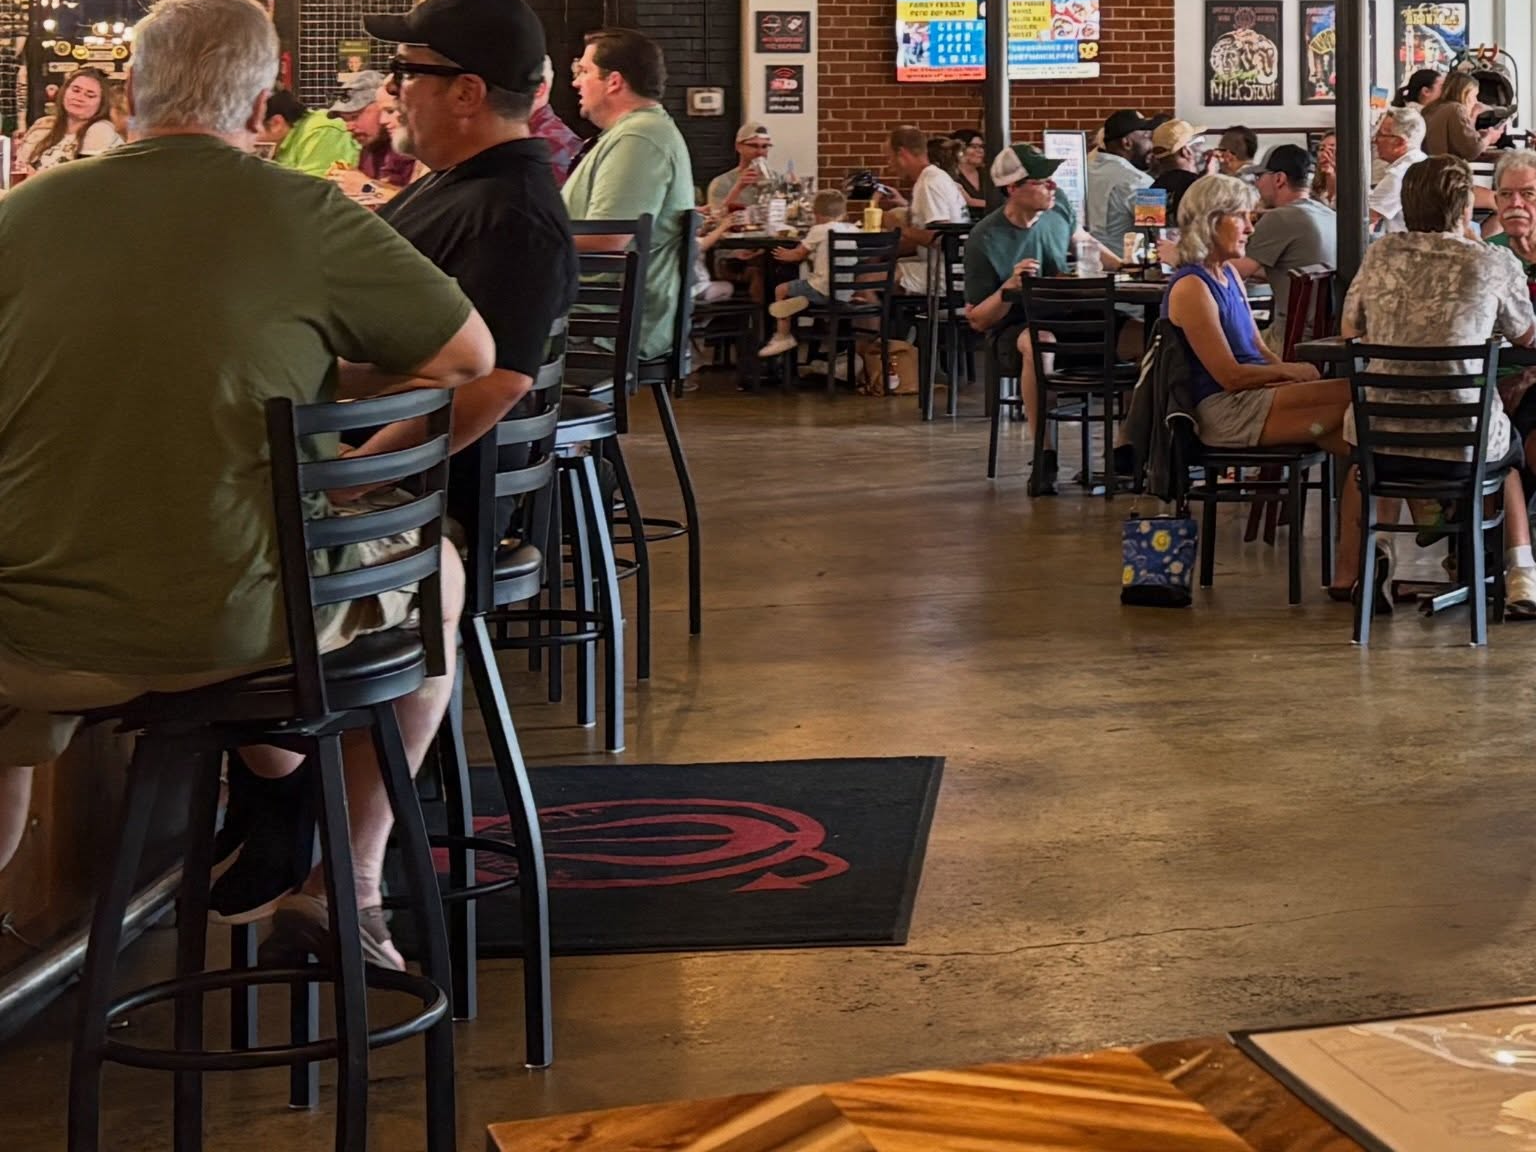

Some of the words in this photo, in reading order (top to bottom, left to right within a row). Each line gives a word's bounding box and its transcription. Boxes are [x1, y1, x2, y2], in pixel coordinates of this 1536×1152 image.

[938, 21, 986, 31] GERMA
[938, 33, 971, 42] FOOD
[938, 44, 971, 53] BEER
